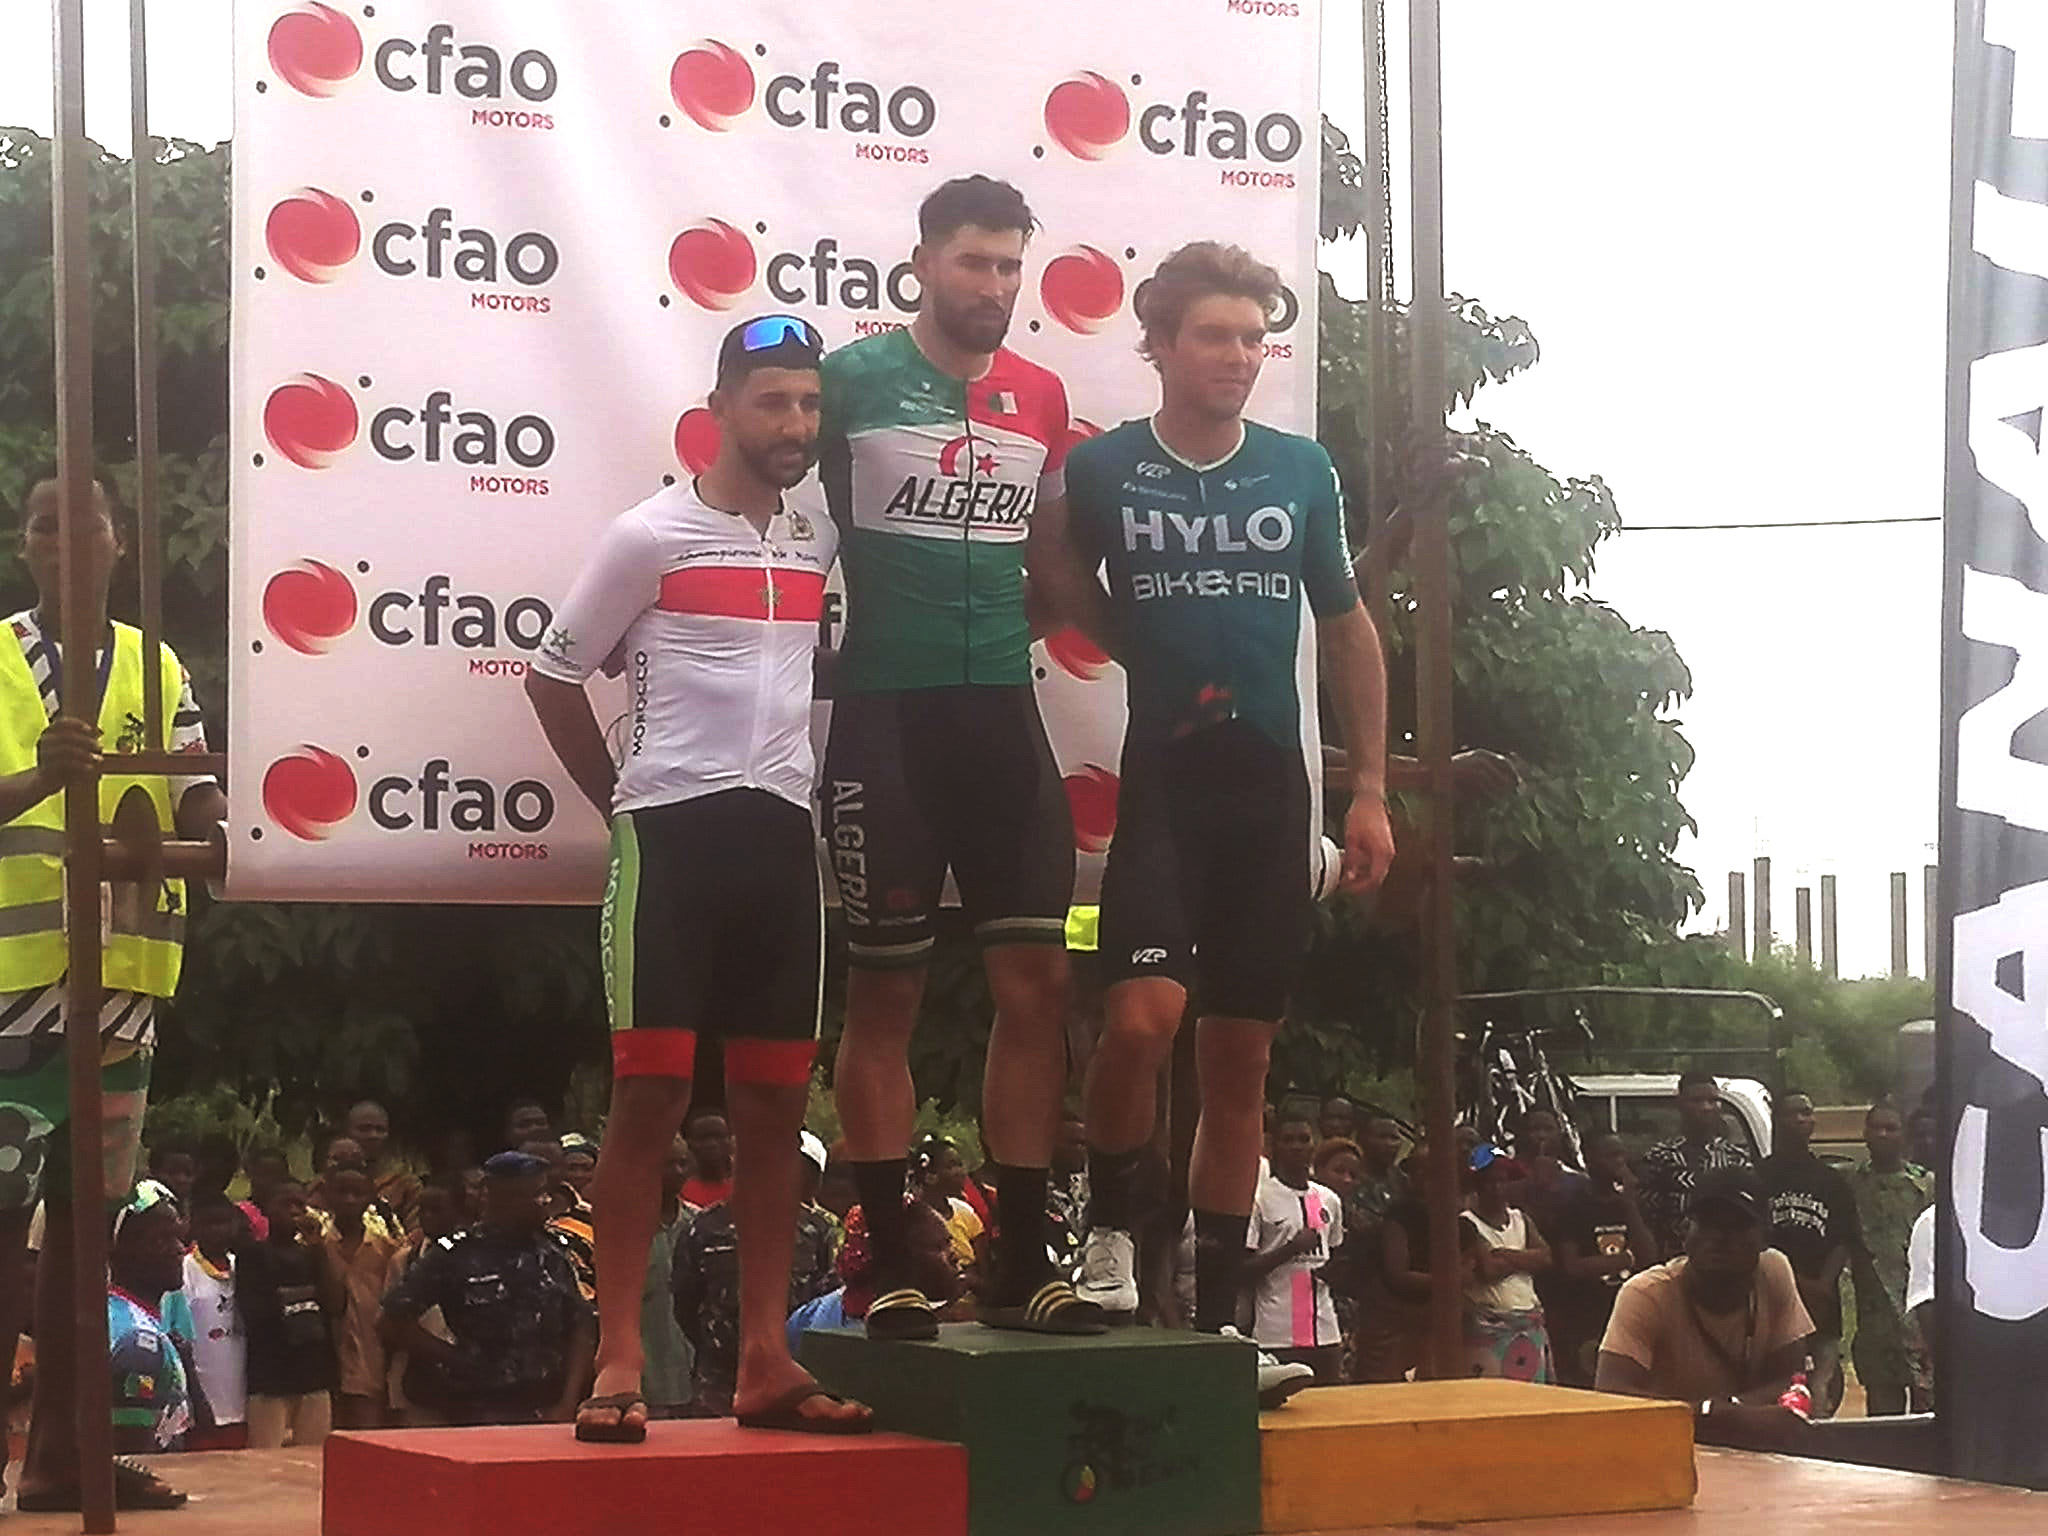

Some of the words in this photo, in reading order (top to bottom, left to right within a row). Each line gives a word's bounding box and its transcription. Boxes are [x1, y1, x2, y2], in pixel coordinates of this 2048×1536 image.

[1227, 0, 1300, 17] MOTORS
[374, 24, 558, 102] cfao
[472, 109, 555, 130] MOTORS
[766, 62, 935, 137] cfao
[1140, 91, 1302, 163] cfao
[856, 143, 930, 164] MOTORS
[1221, 169, 1296, 189] MOTORS
[373, 208, 559, 285] cfao
[767, 239, 922, 313] cfao
[471, 292, 551, 313] MOTORS
[370, 391, 555, 467] cfao
[470, 475, 549, 495] MOTORS
[1122, 506, 1293, 553] HYLO
[369, 575, 553, 650] cfao
[469, 659, 531, 676] MOTO
[369, 759, 555, 833] cfao
[469, 842, 549, 860] MOTORS
